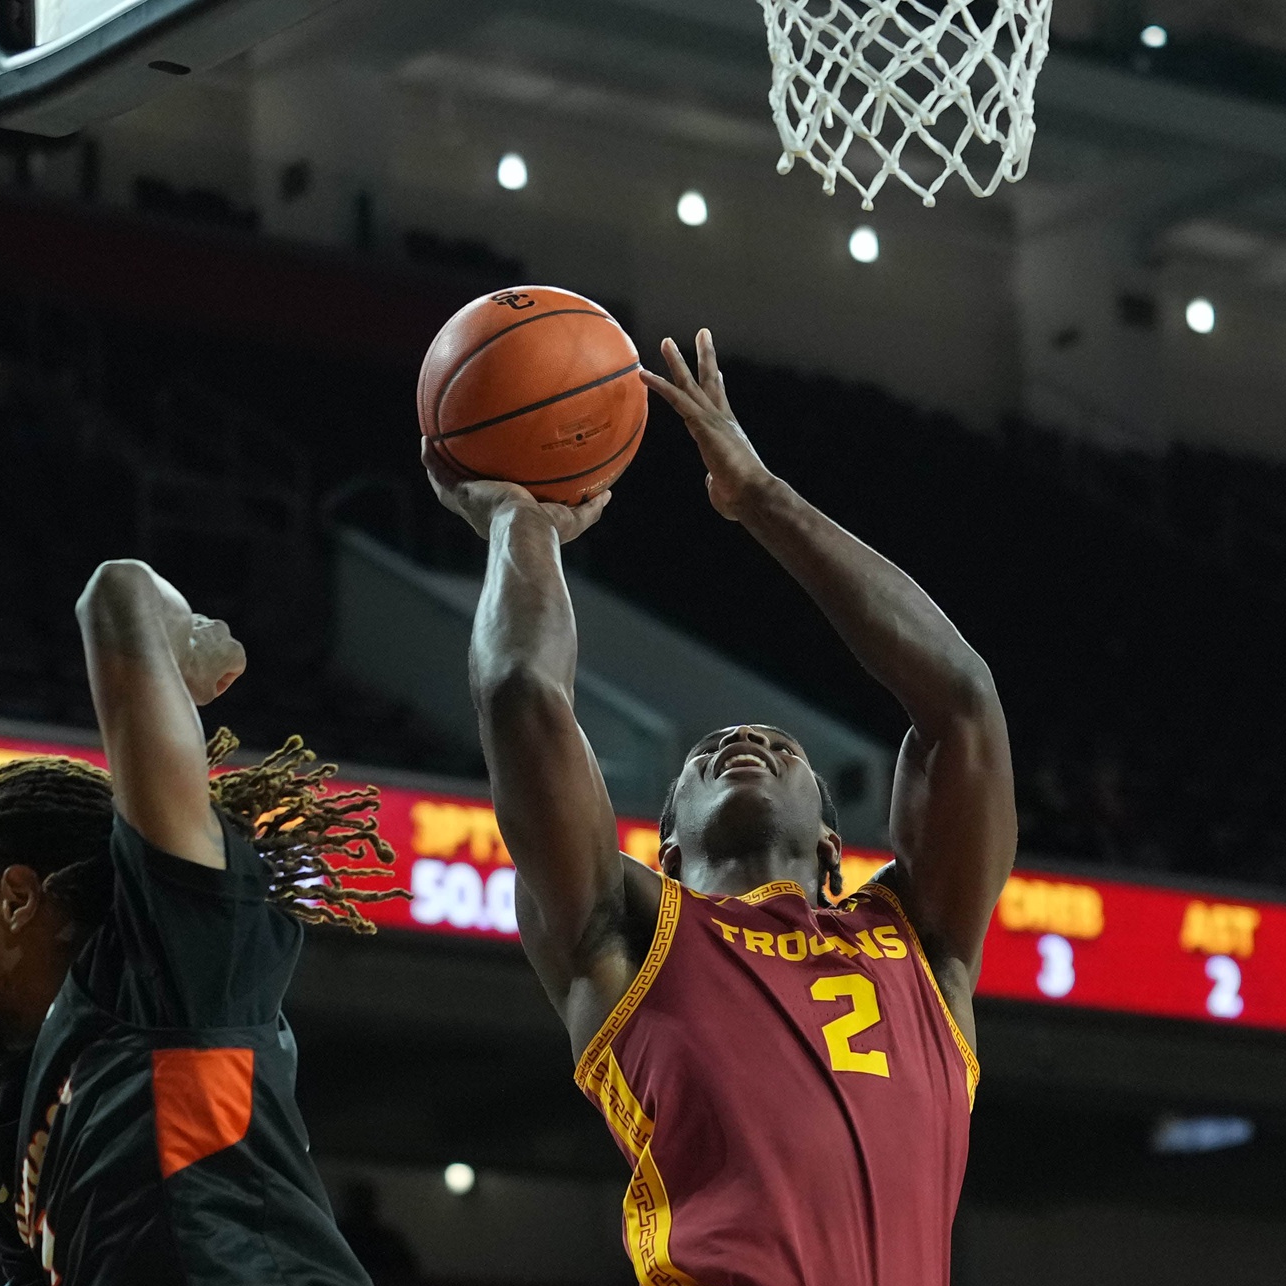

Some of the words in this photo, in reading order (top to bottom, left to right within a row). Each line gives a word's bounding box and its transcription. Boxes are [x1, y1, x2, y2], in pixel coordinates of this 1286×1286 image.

[711, 917, 909, 962] TROJANS
[1204, 954, 1245, 1019] 2
[810, 973, 891, 1079] 2
